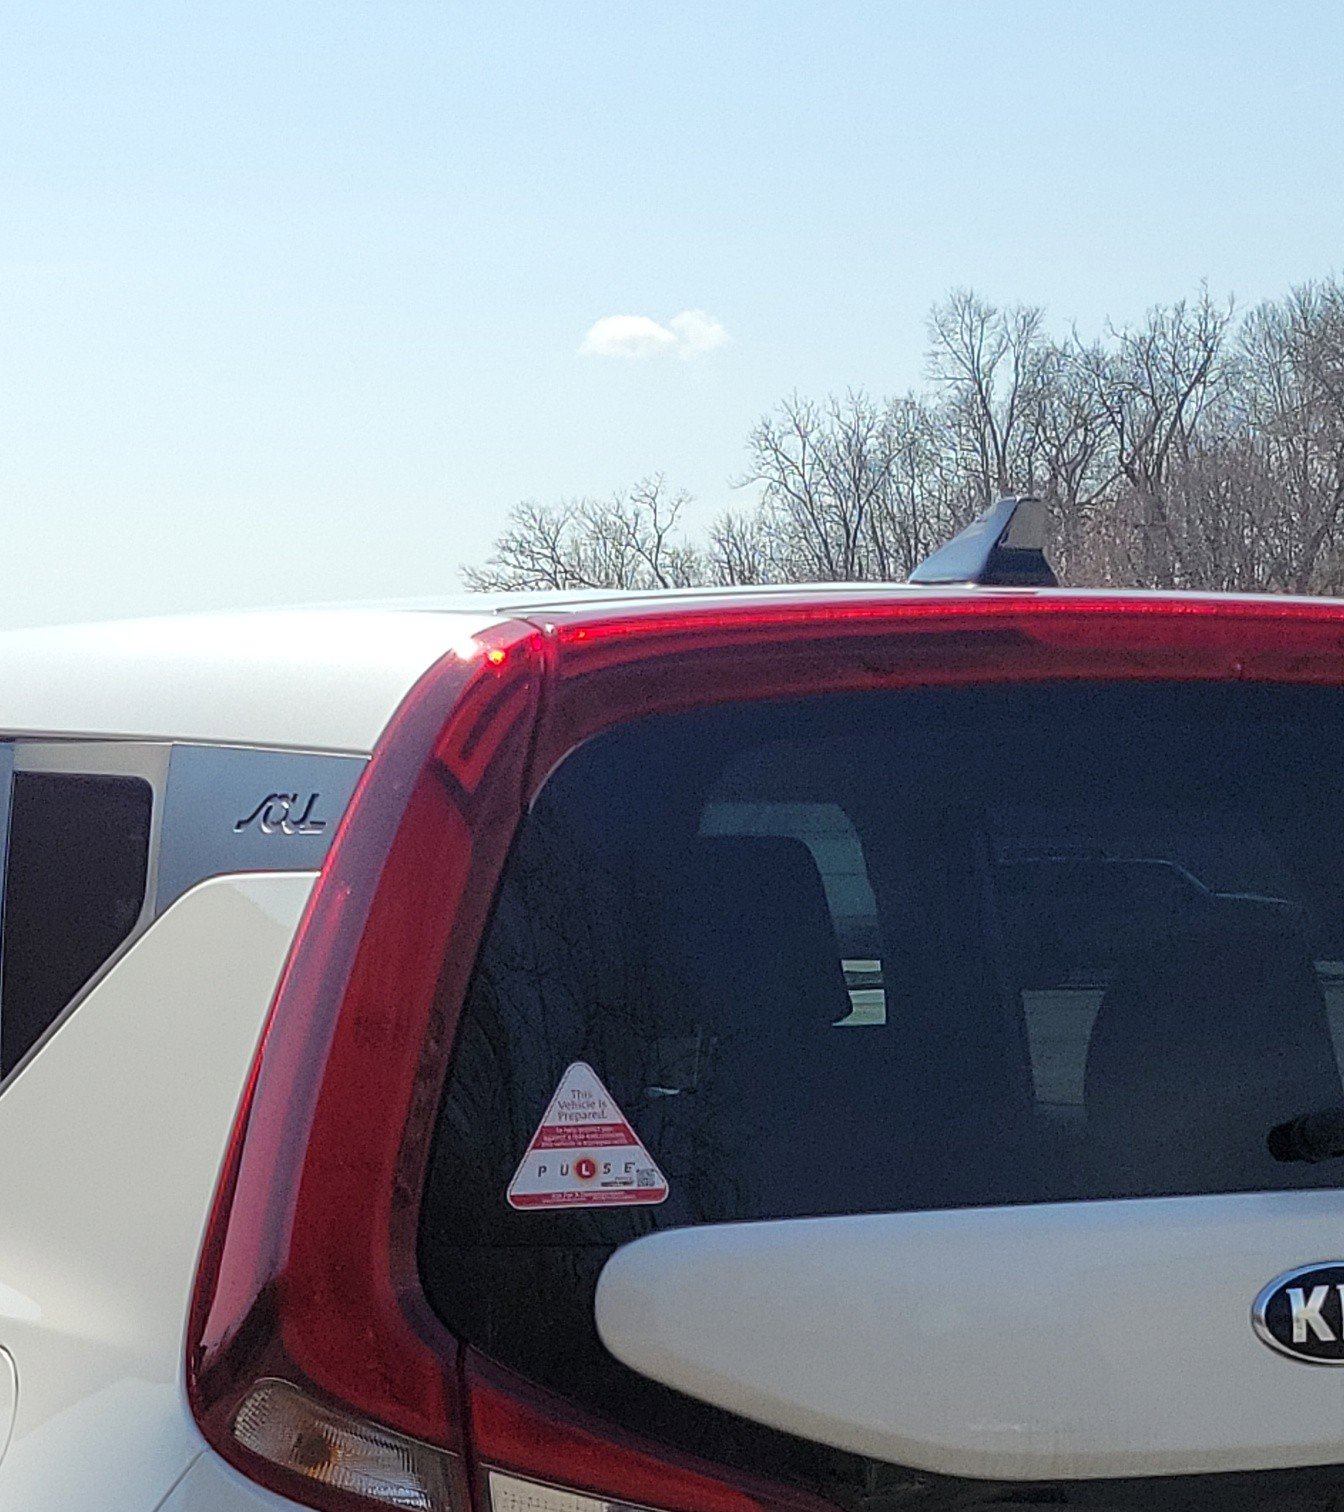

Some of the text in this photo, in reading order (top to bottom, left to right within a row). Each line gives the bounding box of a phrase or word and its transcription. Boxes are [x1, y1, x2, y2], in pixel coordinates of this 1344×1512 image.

[570, 1089, 593, 1099] This
[557, 1100, 596, 1110] Vehicle
[537, 1162, 635, 1178] PULSE
